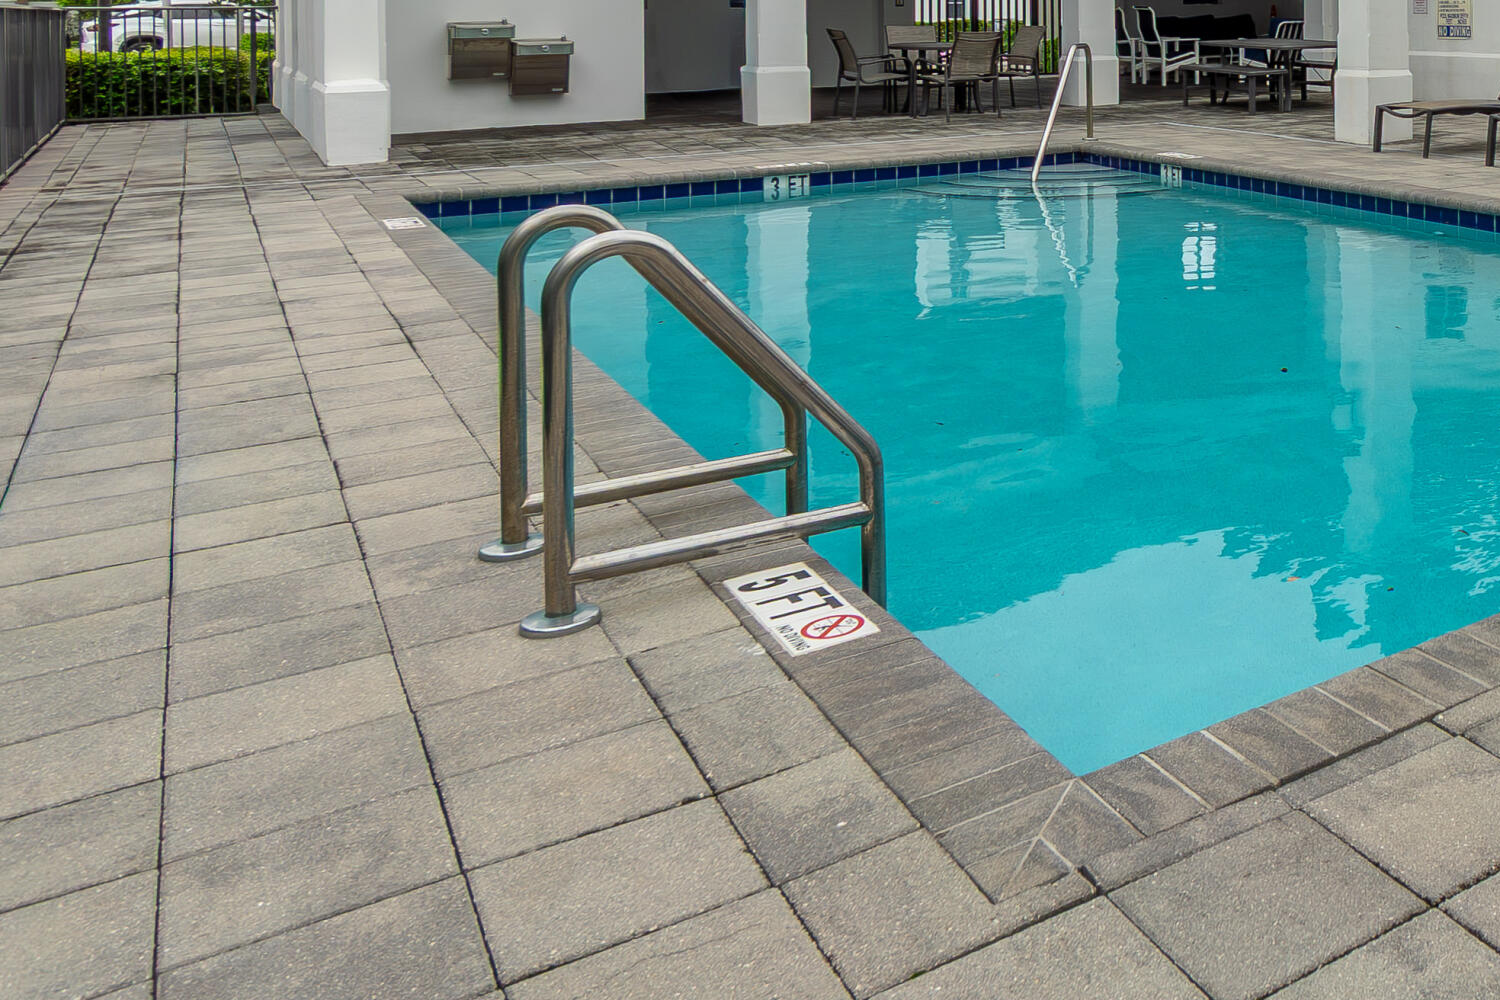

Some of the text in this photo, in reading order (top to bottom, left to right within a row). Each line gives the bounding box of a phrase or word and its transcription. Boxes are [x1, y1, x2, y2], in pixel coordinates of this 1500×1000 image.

[738, 569, 844, 620] 5 FT
[776, 624, 811, 651] NO DIVING
